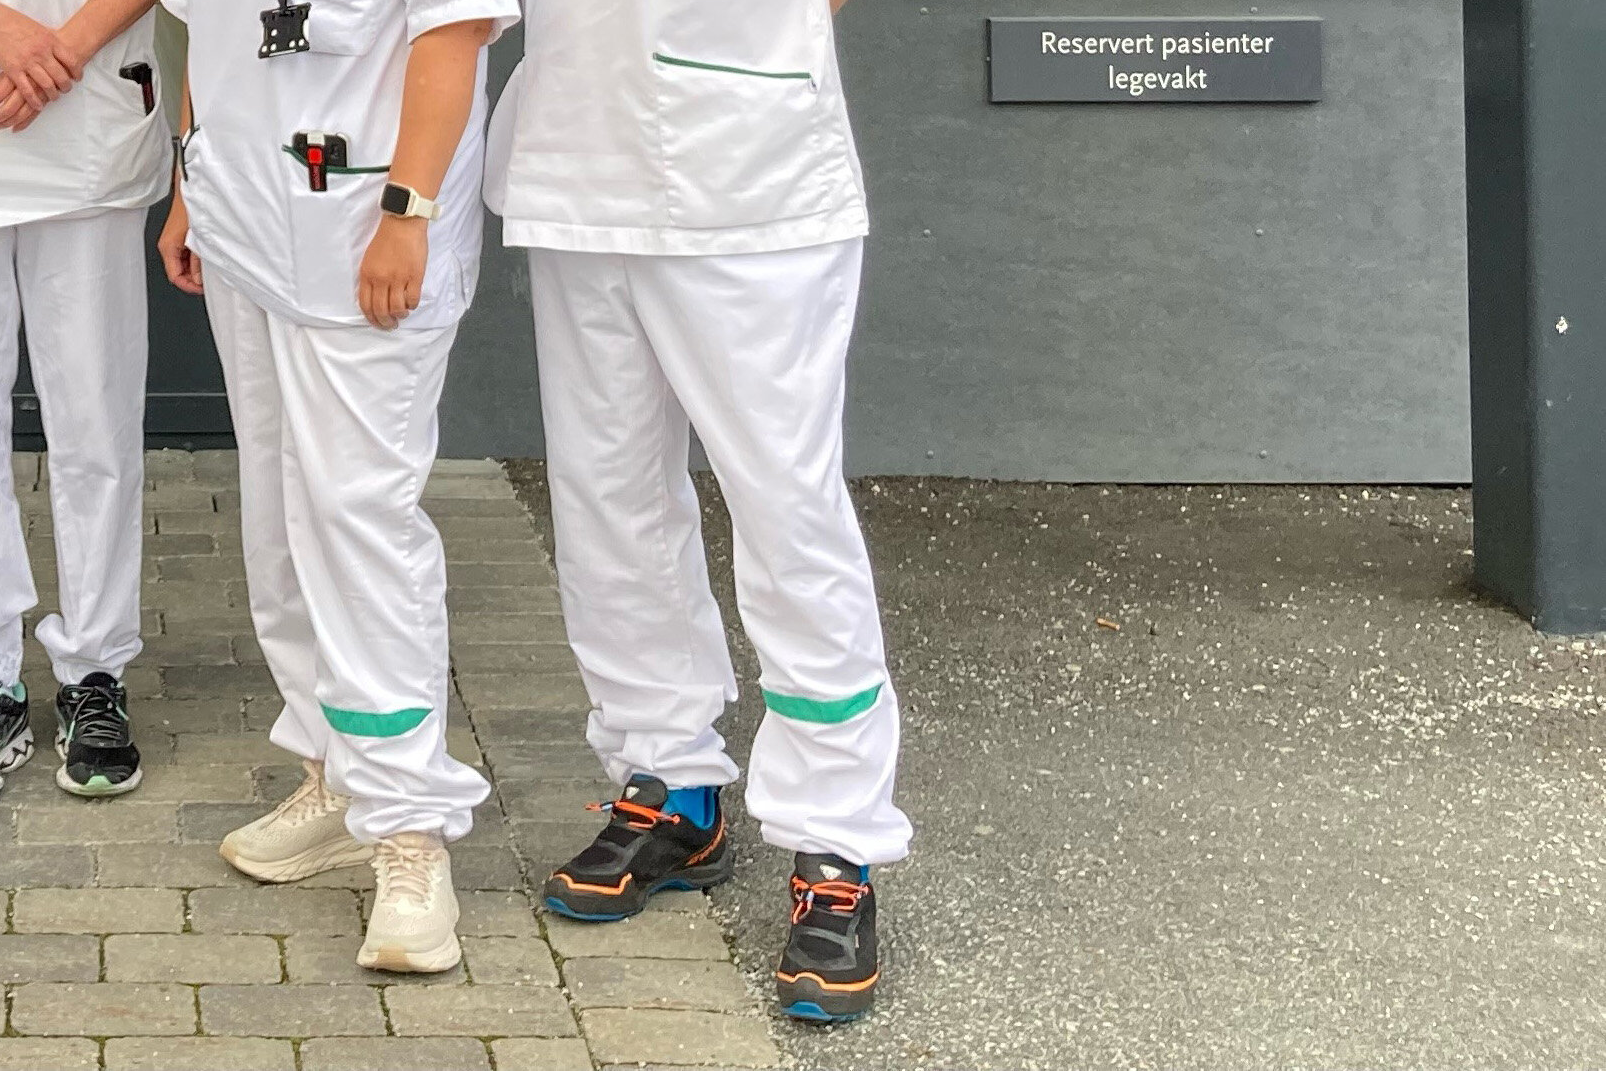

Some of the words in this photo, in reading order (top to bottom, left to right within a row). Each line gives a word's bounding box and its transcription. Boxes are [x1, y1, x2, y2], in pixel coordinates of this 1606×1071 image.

[1041, 31, 1154, 55] Reservert
[1162, 31, 1275, 61] pasienter
[1108, 64, 1208, 97] legevakt
